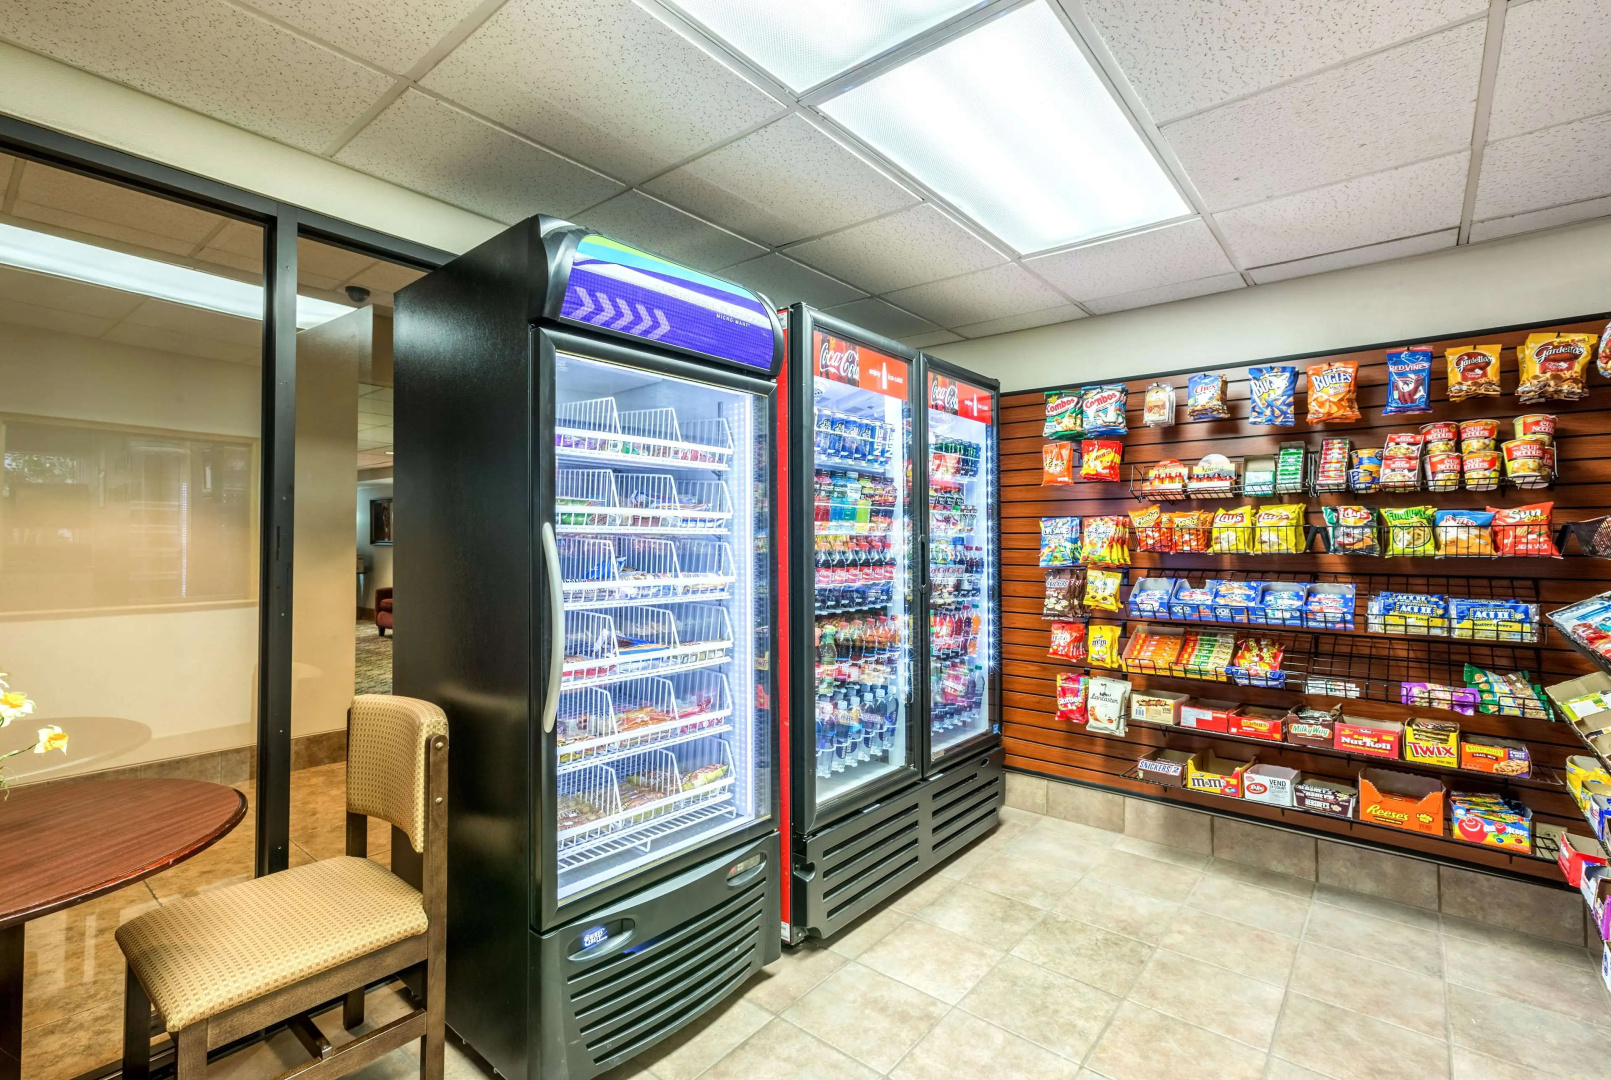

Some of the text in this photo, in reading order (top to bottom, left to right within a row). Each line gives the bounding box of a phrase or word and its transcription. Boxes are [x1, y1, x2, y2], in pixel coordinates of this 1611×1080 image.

[716, 313, 734, 323] MICRO
[1532, 343, 1586, 364] Gardetto's
[1453, 352, 1496, 373] Gardetto's
[1194, 383, 1217, 394] Chex
[1310, 372, 1352, 392] BUGLES
[1046, 398, 1075, 413] Combos
[1084, 392, 1117, 409] Combos
[1431, 427, 1449, 435] CUP
[1462, 431, 1489, 439] NOODLES
[1513, 444, 1543, 457] CUP NOODLES
[1506, 508, 1541, 523] Sun
[1400, 605, 1419, 613] ACT
[1474, 609, 1509, 620] ACT II
[1341, 736, 1364, 746] Nut
[1365, 740, 1392, 750] Roll
[1139, 760, 1180, 774] SNICKERS 2
[1269, 779, 1287, 787] VEND
